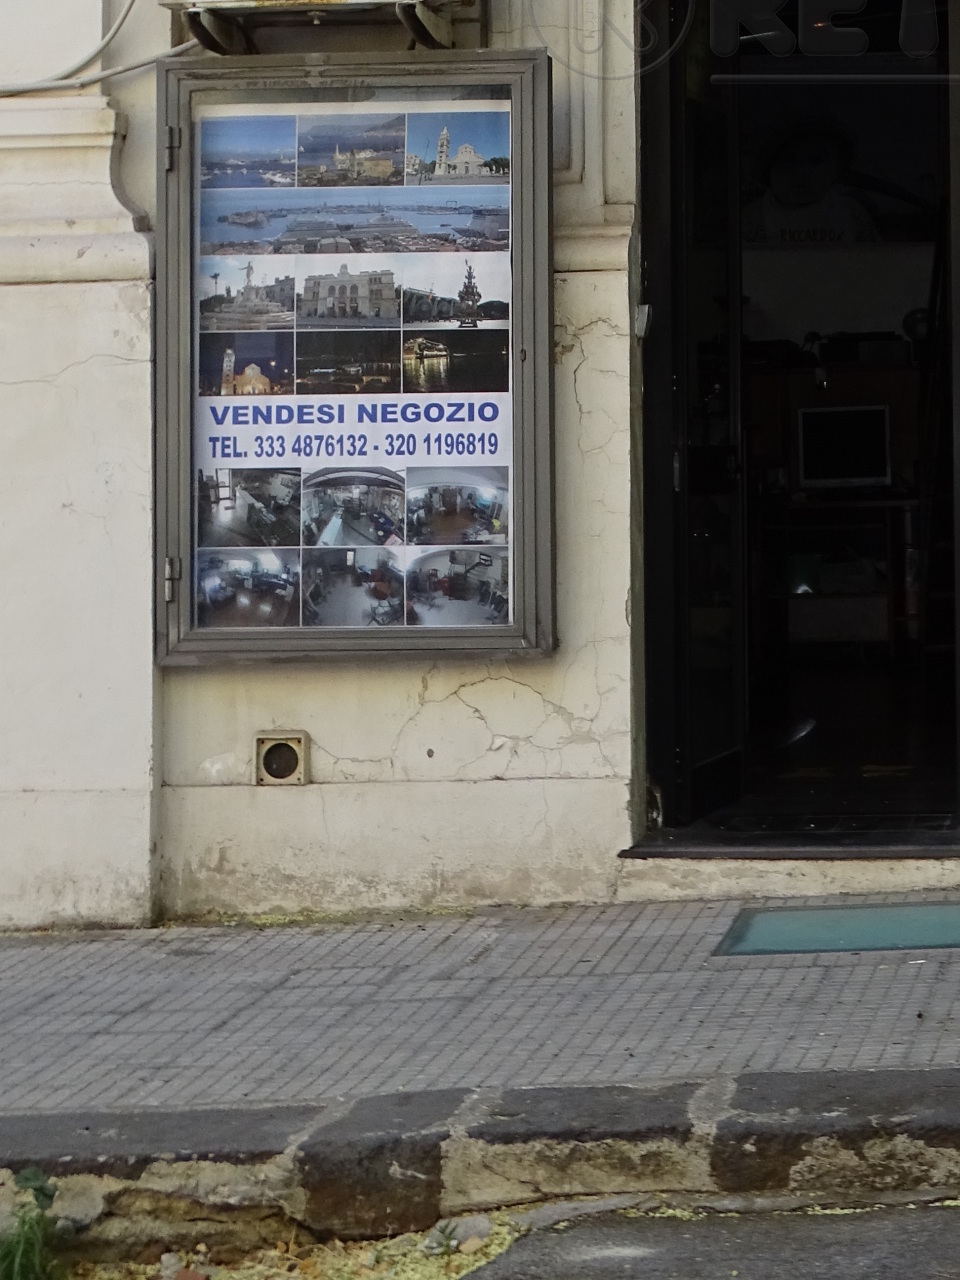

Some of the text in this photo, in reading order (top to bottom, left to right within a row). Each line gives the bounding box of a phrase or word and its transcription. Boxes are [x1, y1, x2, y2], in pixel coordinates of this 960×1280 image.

[210, 402, 499, 425] VENDESI NEGOZIO
[209, 436, 248, 458] TEL.
[254, 435, 286, 457] 333
[291, 434, 367, 456] 4876132
[384, 433, 416, 455] 320
[423, 432, 498, 455] 1196819
